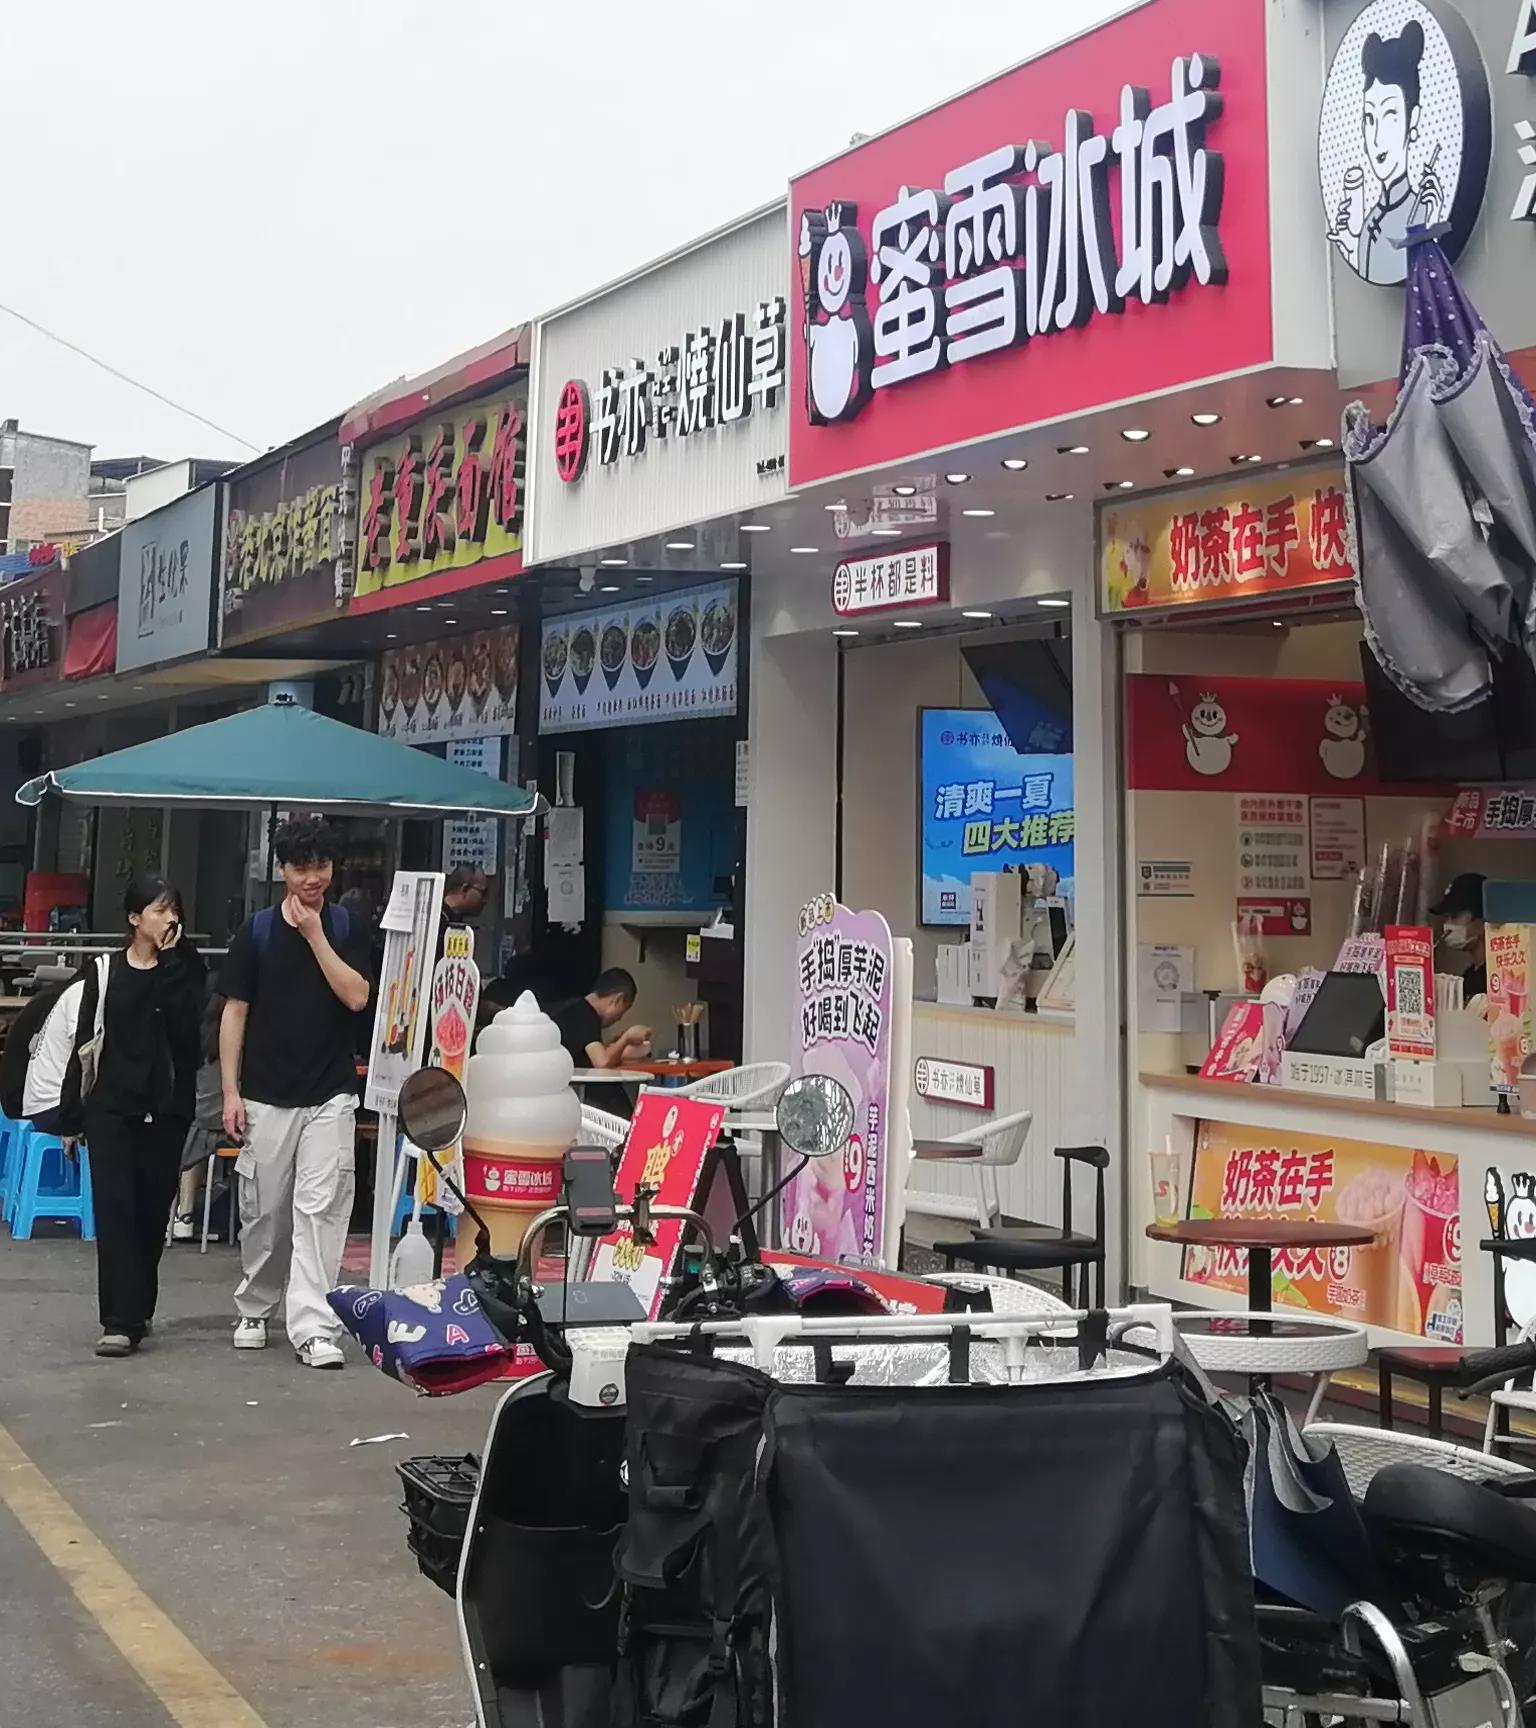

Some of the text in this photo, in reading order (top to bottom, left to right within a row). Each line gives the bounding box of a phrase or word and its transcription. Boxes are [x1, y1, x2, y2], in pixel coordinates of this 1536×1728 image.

[870, 52, 1219, 390] 蜜雪冰城
[1170, 494, 1298, 584] 奶茶在手
[855, 553, 935, 602] 半杯都是料
[935, 773, 1054, 820] 清爽一夏
[963, 809, 1075, 857] 四大推荐
[802, 992, 881, 1054] 好喝到飞起
[503, 1168, 553, 1187] 蜜雪冰城
[1222, 1148, 1335, 1212] 奶茶在手
